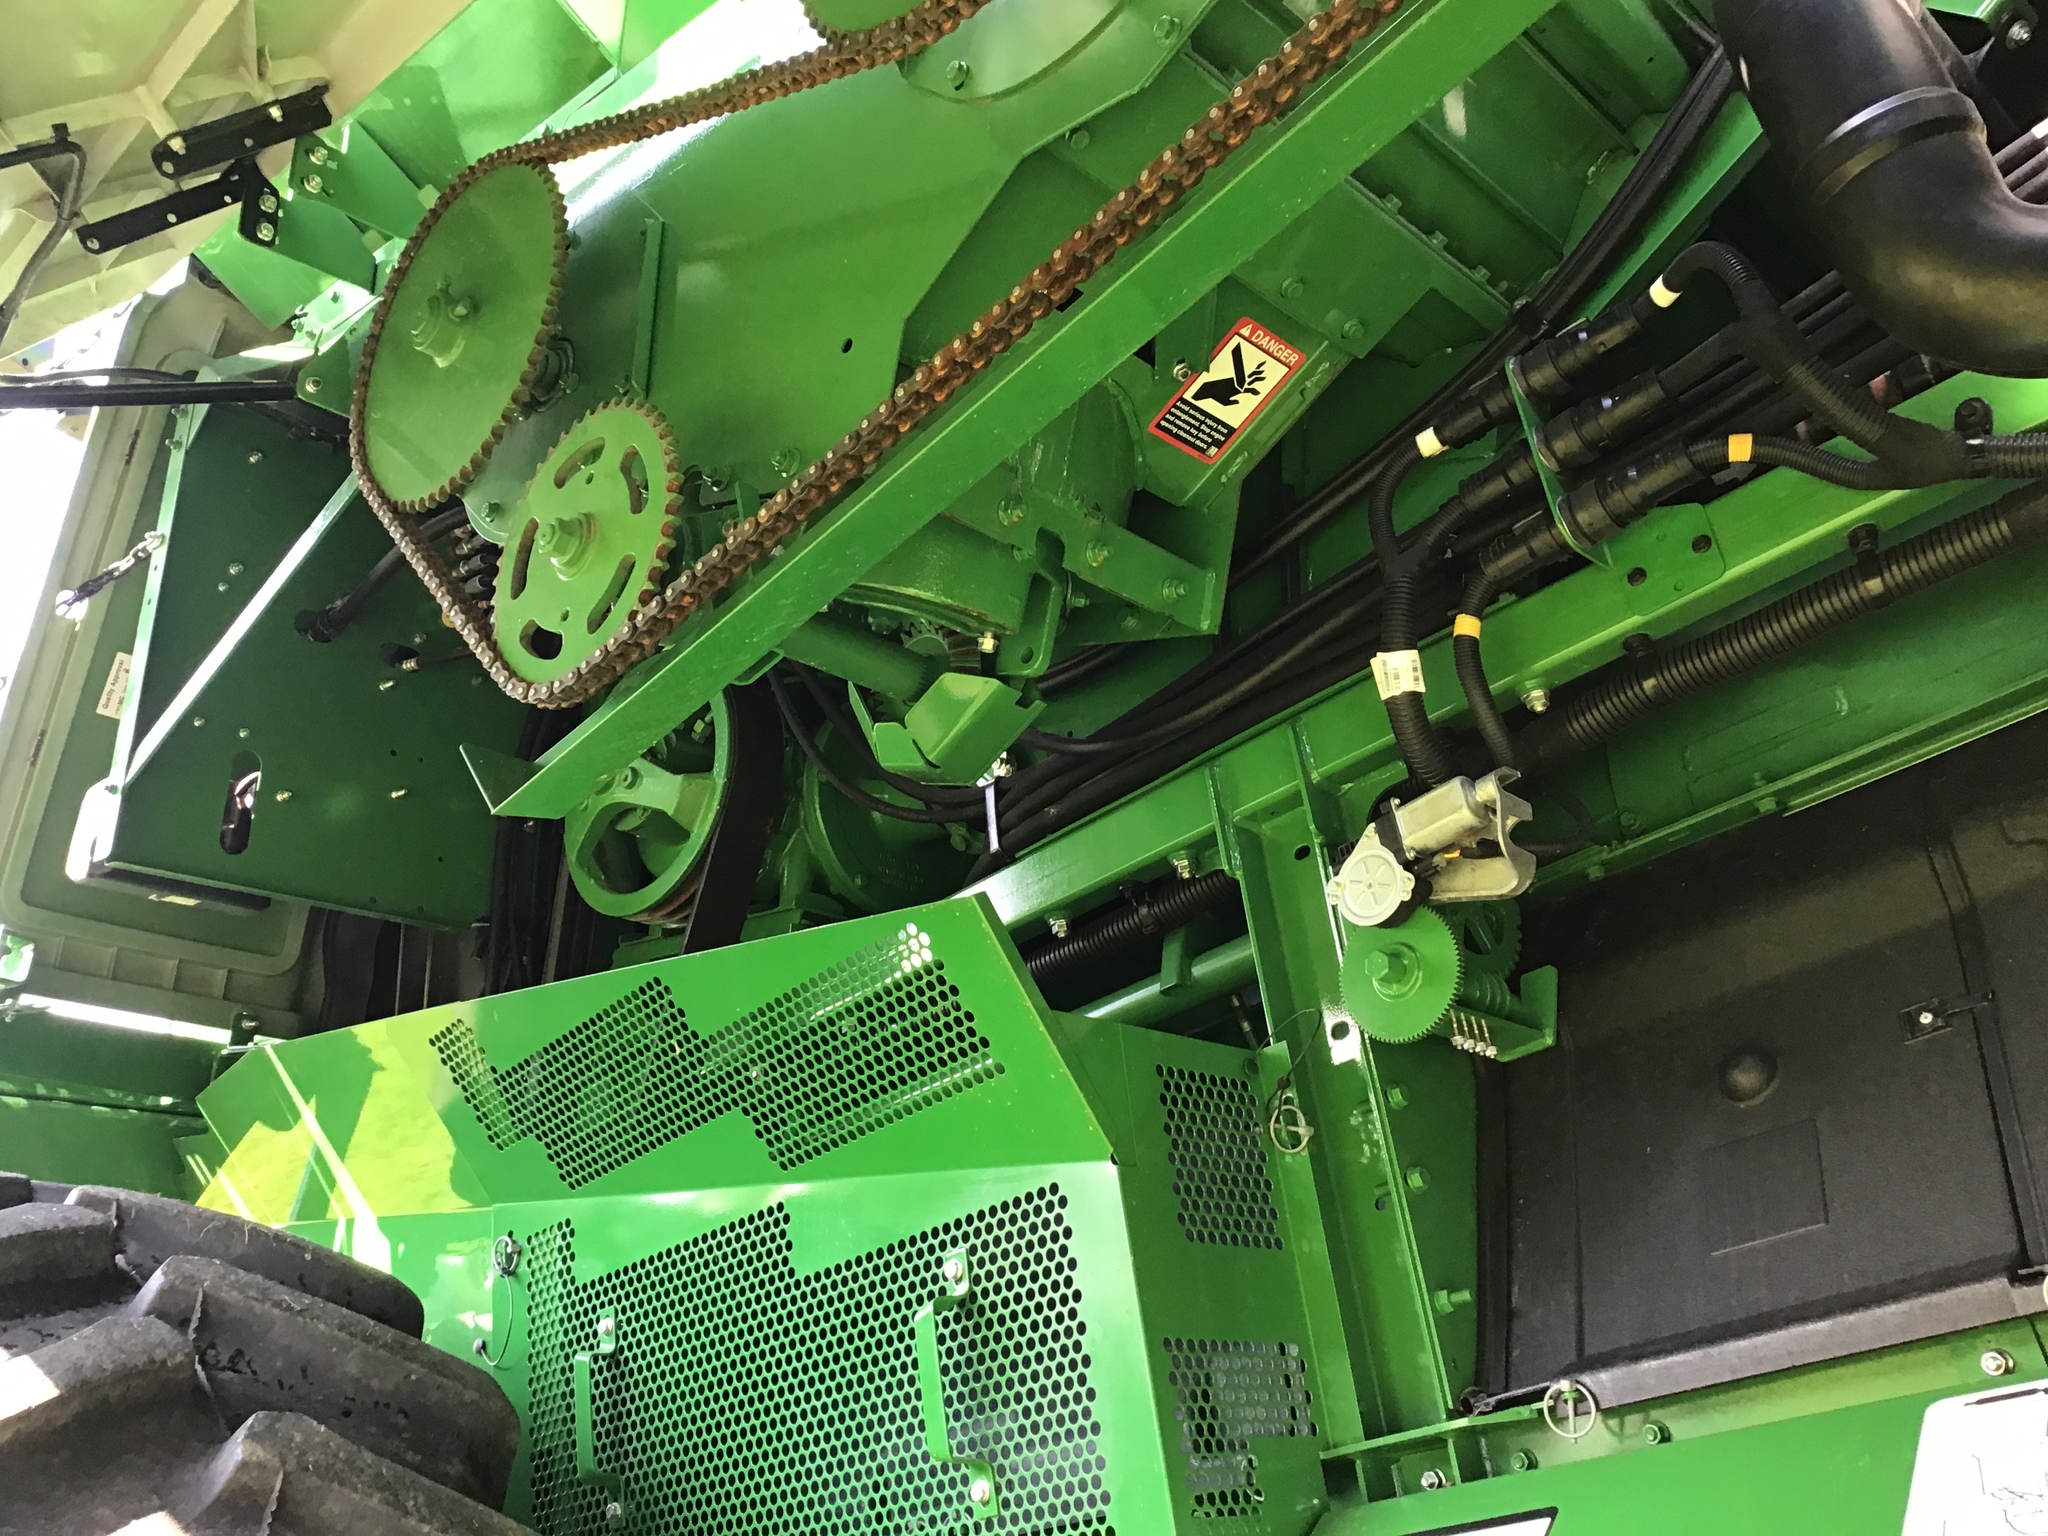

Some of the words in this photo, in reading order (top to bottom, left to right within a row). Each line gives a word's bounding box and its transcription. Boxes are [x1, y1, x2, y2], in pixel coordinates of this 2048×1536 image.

[1251, 330, 1300, 367] DANGER
[1159, 419, 1178, 434] opening
[1176, 429, 1197, 443] cleanout
[1164, 413, 1176, 422] and
[1173, 418, 1191, 431] remove
[1189, 427, 1199, 436] key
[1197, 432, 1213, 443] before
[1175, 400, 1190, 412] Avoid
[1188, 408, 1206, 421] serious
[1204, 417, 1218, 429] injury
[1217, 424, 1229, 434] from
[1199, 423, 1212, 434] Stop
[1210, 430, 1226, 441] engine
[101, 688, 115, 710] Quality
[110, 659, 124, 687] Approval
